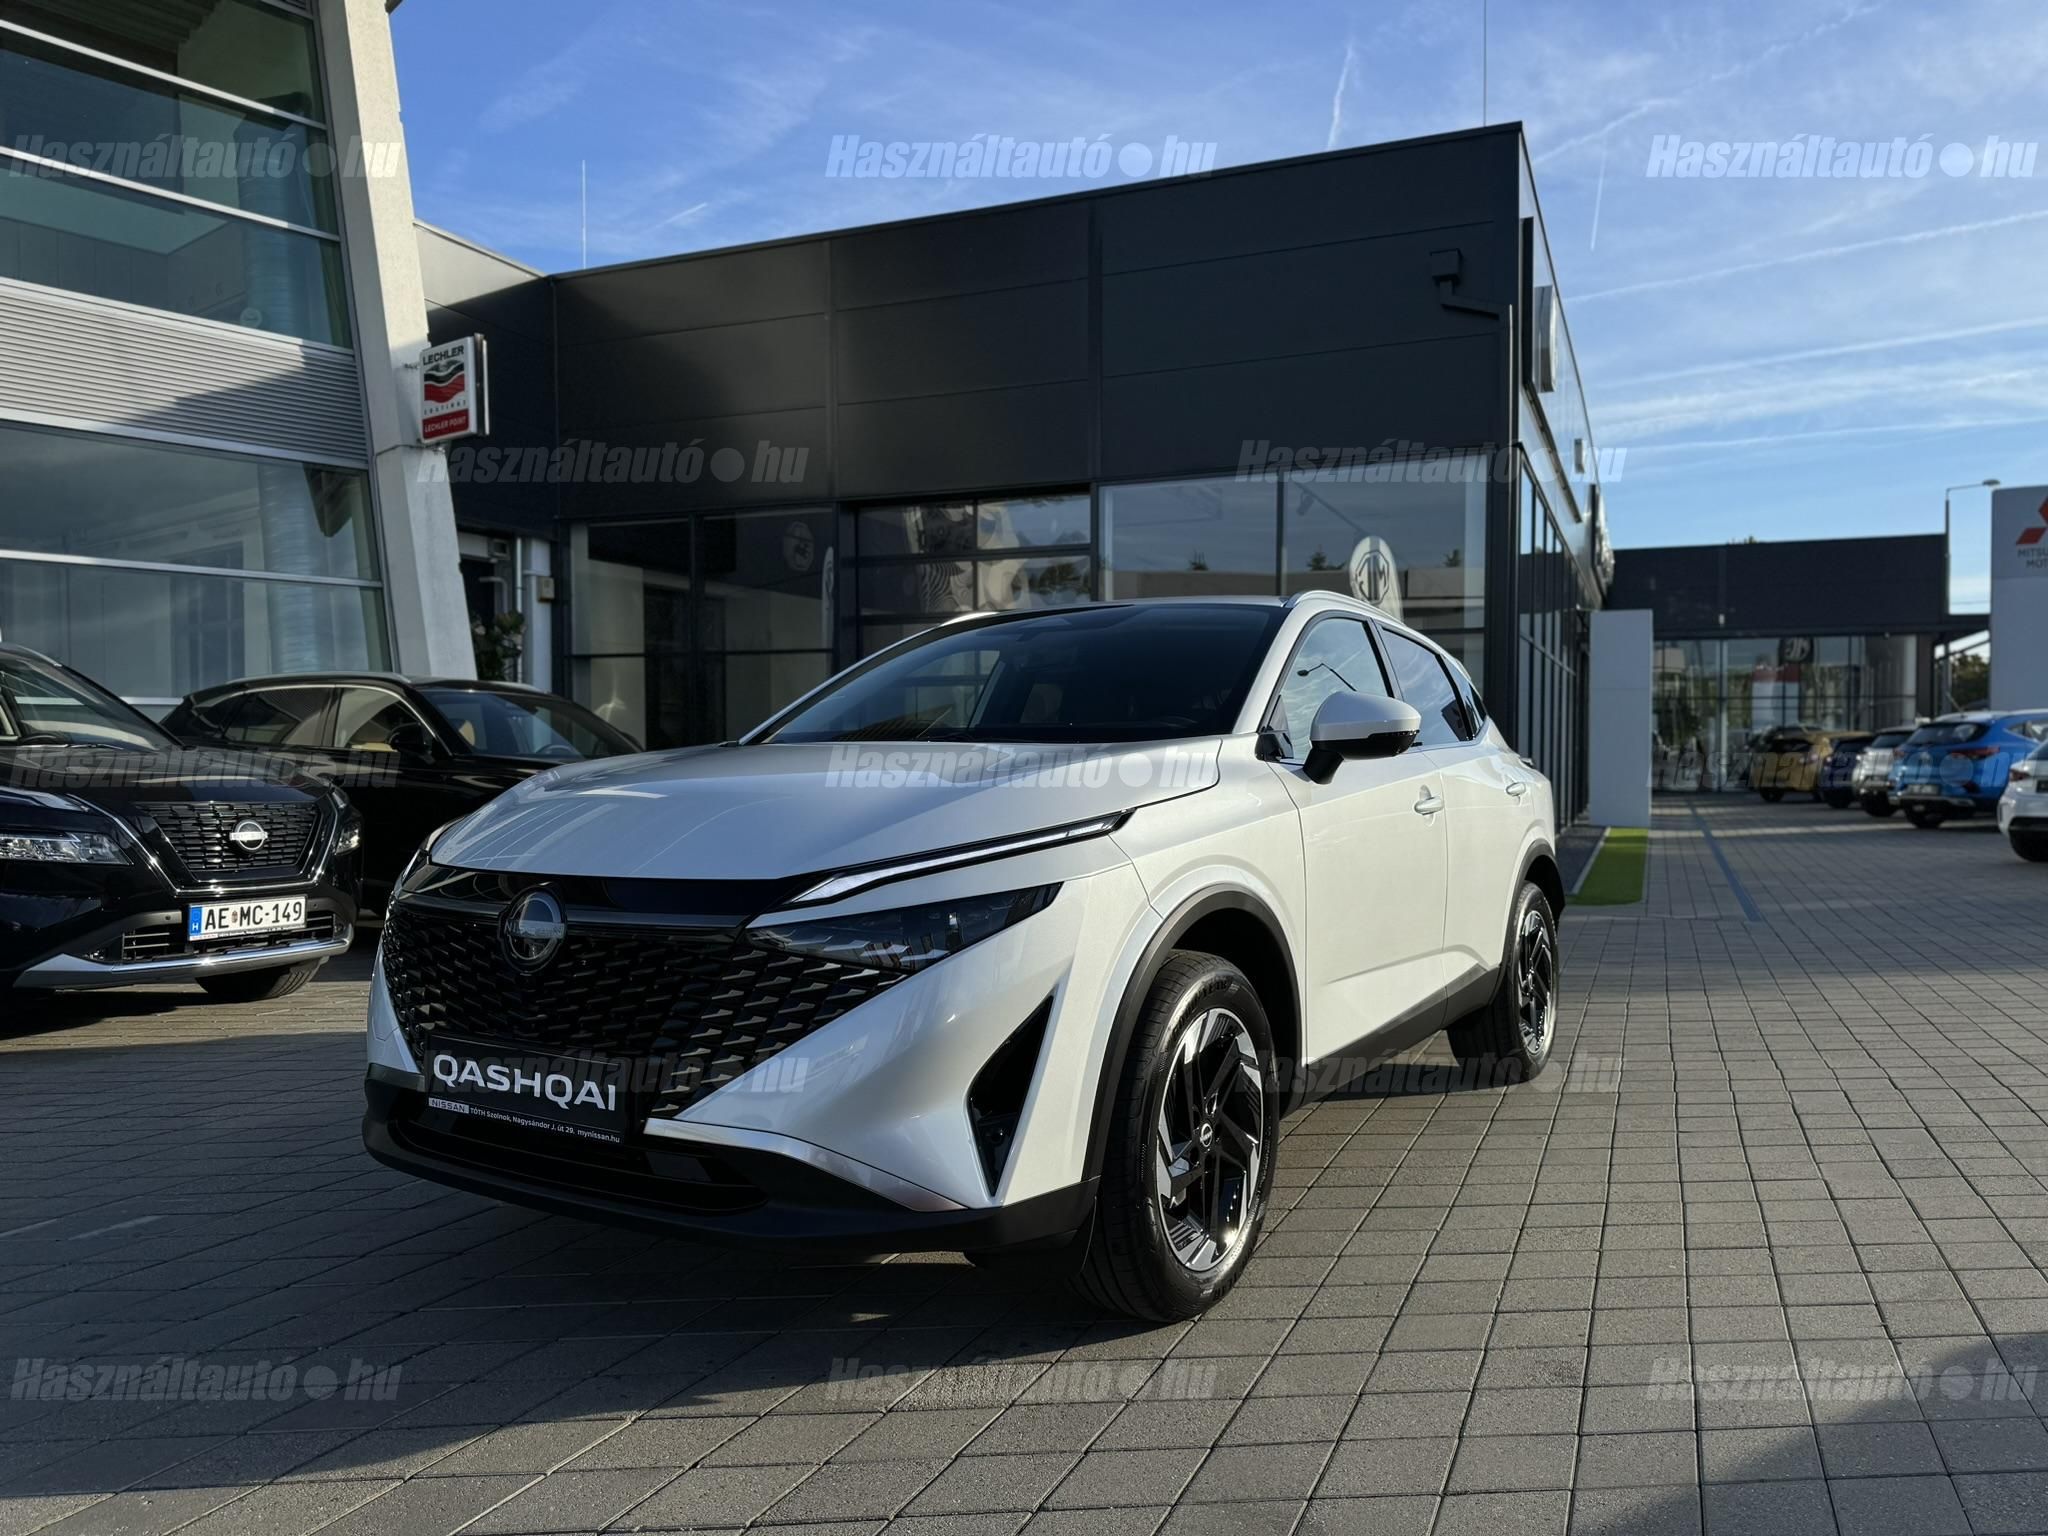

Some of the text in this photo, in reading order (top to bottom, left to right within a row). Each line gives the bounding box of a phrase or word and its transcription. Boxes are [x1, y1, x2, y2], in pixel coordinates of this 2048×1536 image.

[423, 345, 465, 366] LECHLER
[424, 419, 449, 433] LECHLER
[433, 1054, 616, 1111] QASHQAI
[431, 1098, 465, 1113] NISSAN
[470, 1107, 486, 1117] TÓTH
[486, 1111, 511, 1122] Szolnok,
[512, 1116, 550, 1129] Nagysándor
[577, 1129, 620, 1143] mynissan.hu
